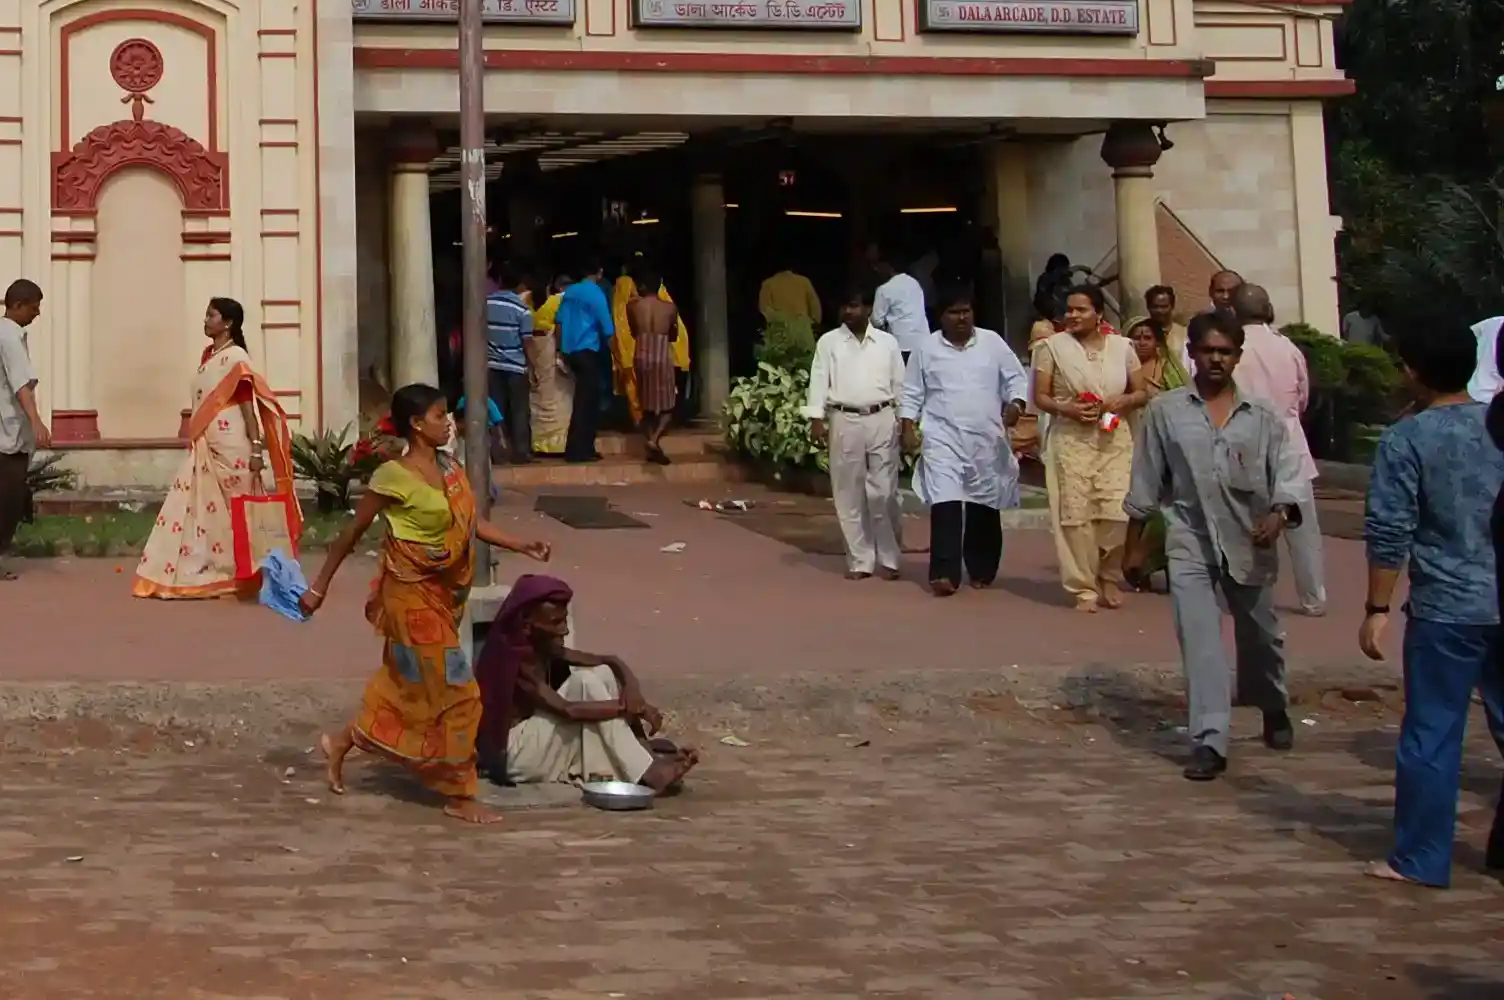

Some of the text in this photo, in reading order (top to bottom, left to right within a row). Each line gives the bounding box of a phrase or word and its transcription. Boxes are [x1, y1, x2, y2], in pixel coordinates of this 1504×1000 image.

[674, 3, 706, 18] ডালা
[712, 0, 757, 18] আর্কেড
[958, 5, 992, 21] DALA
[1051, 7, 1074, 23] D.D.
[1077, 8, 1127, 25] ESTATE
